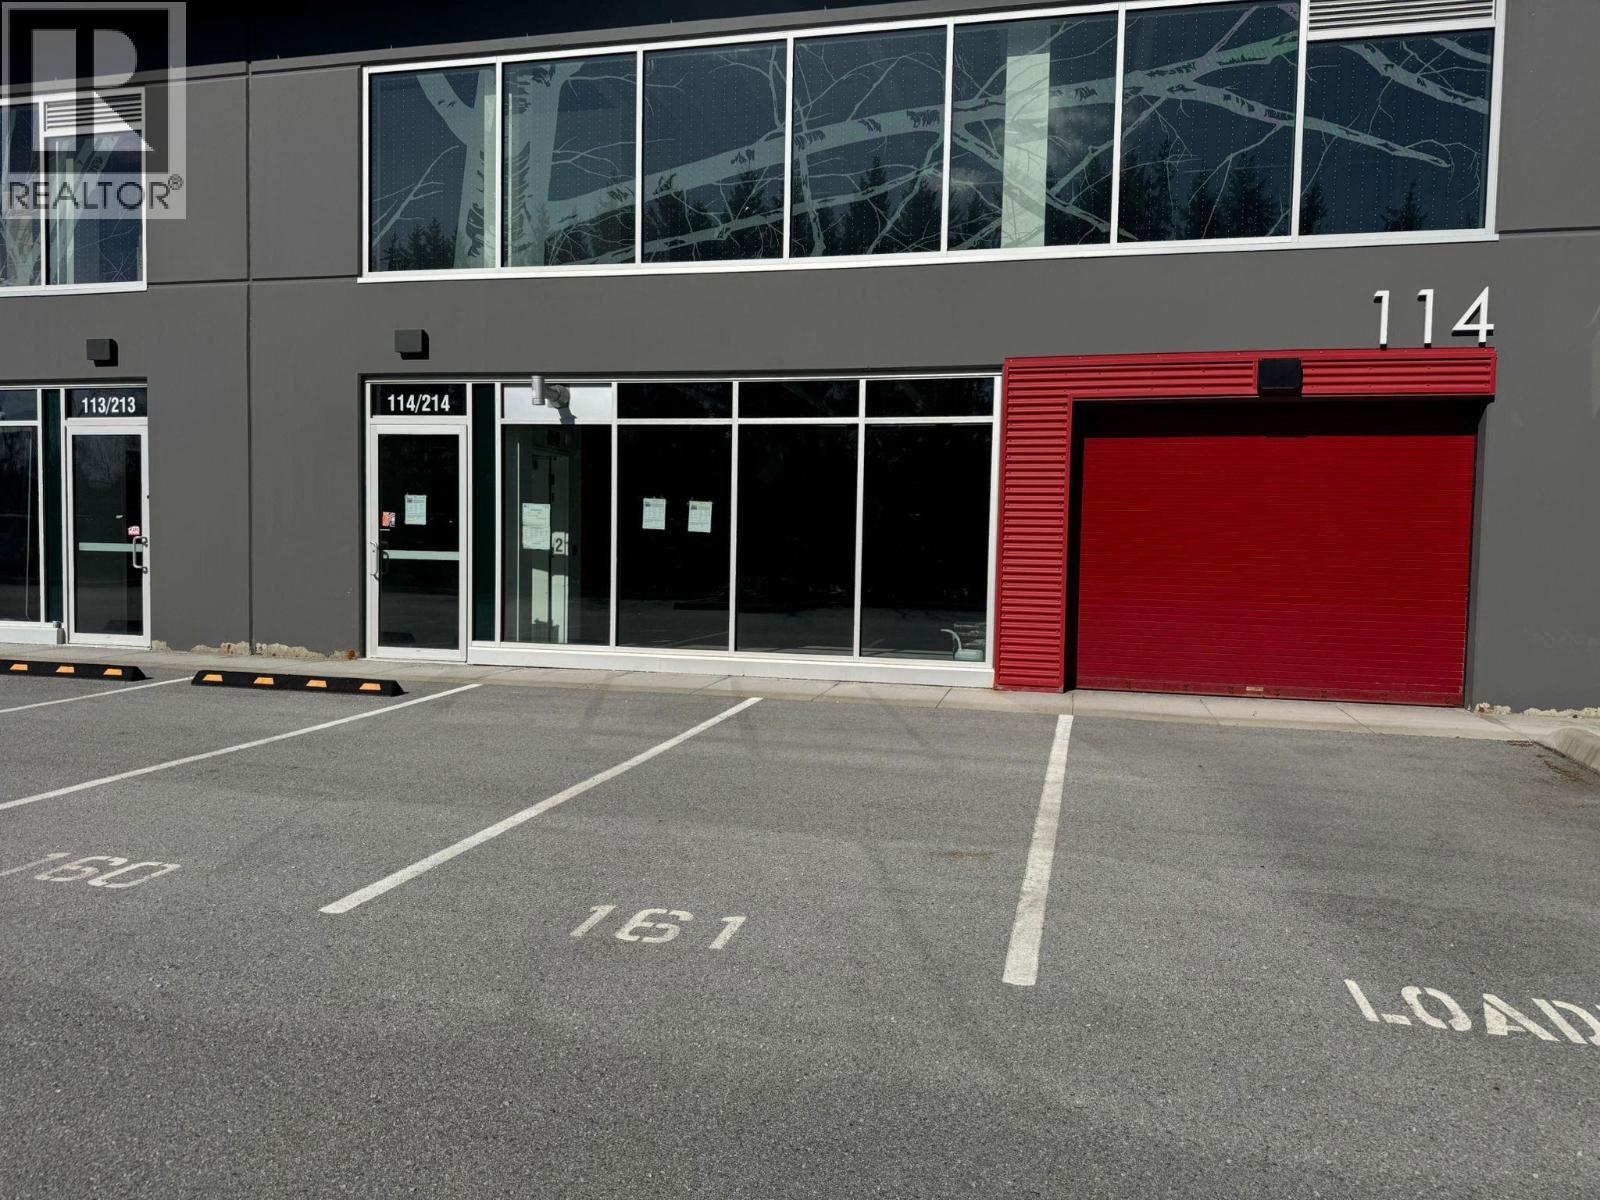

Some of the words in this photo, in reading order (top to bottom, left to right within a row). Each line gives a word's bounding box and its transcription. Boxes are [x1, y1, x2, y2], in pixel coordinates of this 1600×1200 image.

[1373, 286, 1495, 346] 114
[81, 396, 136, 415] 113/213
[387, 393, 451, 413] 114/214
[0, 852, 181, 888] 160
[569, 904, 748, 950] 161
[1343, 978, 1600, 1047] LOAD
